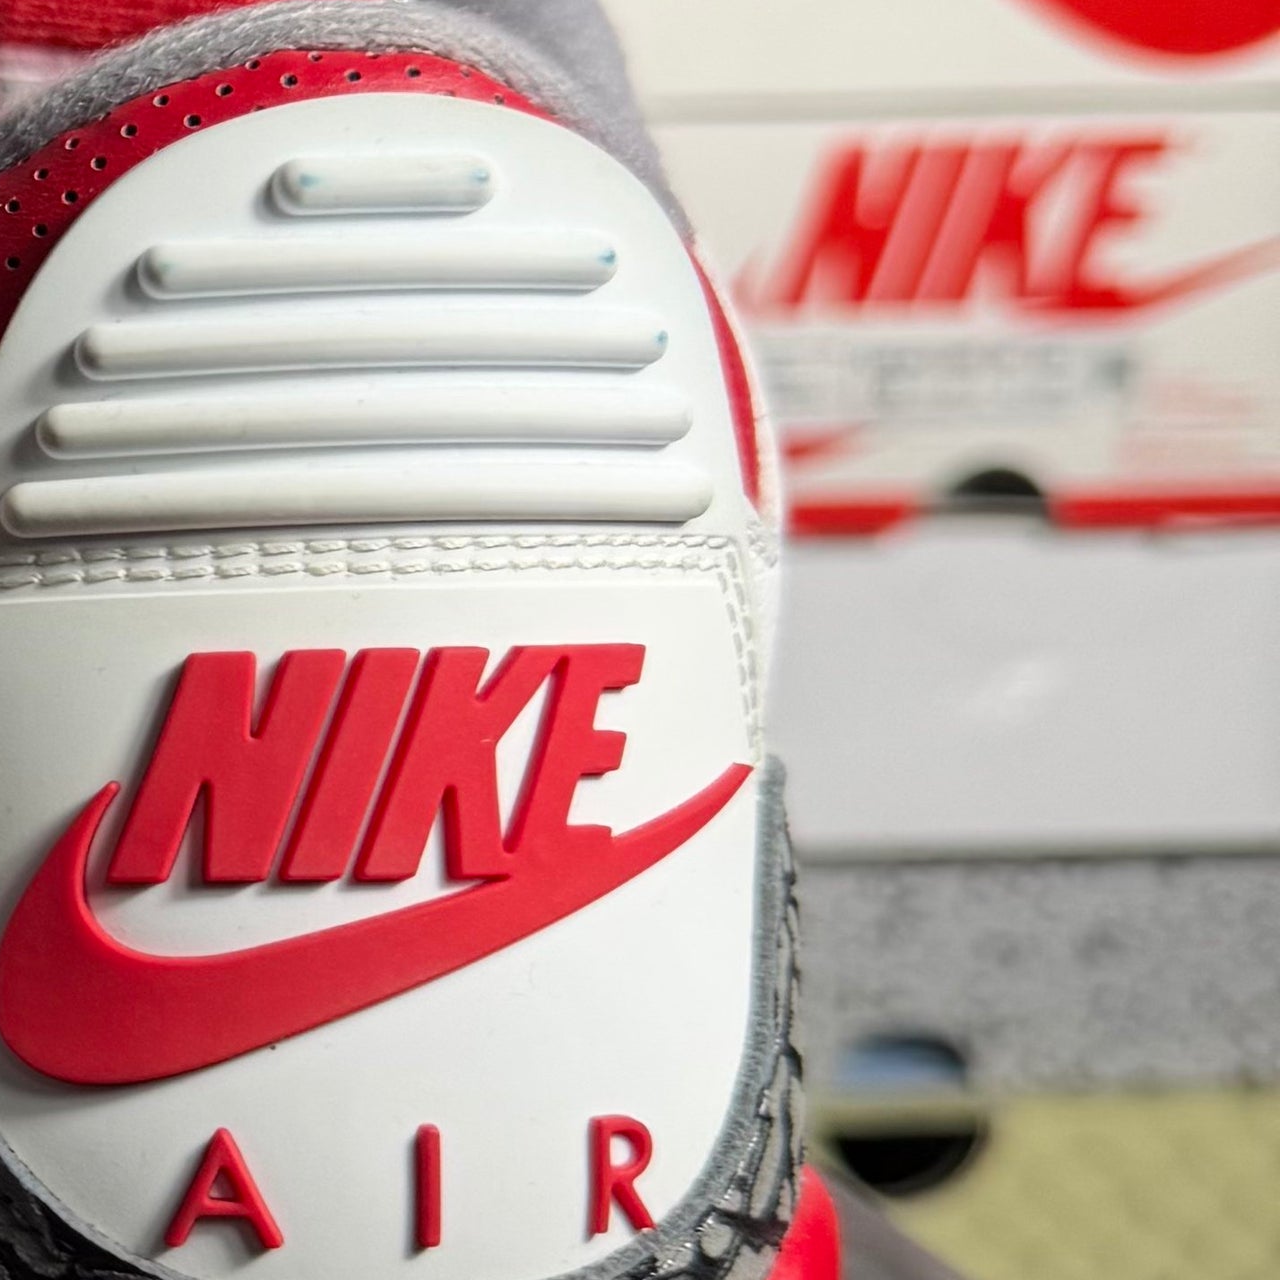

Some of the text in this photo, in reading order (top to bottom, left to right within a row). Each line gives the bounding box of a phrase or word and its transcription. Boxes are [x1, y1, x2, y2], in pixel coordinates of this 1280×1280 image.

[762, 126, 1178, 318] NIKE
[104, 642, 646, 885] NIKE
[164, 1114, 657, 1251] AIR
